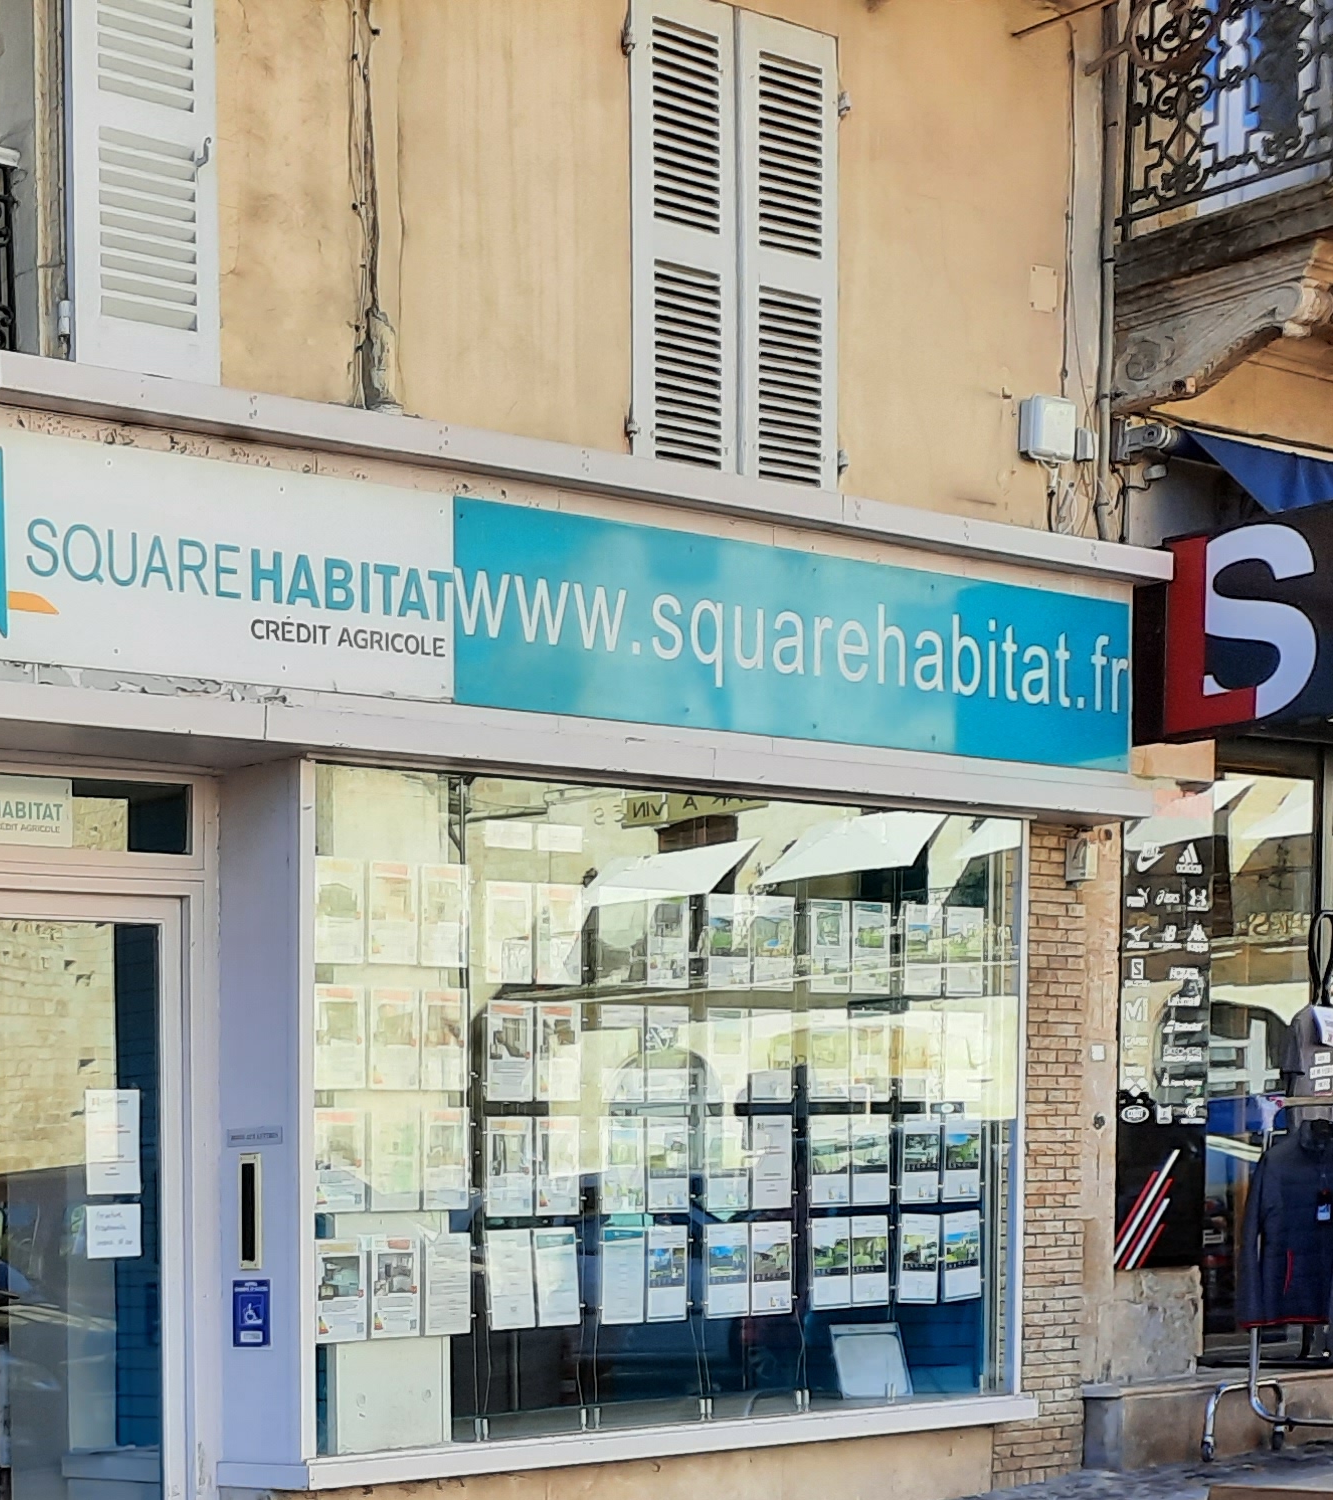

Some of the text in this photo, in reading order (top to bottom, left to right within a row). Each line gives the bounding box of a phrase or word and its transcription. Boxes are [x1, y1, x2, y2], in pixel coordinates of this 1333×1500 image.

[250, 615, 447, 658] CRÉDIT AGRICOLE
[453, 566, 1130, 714] www.squarehabitat.fr
